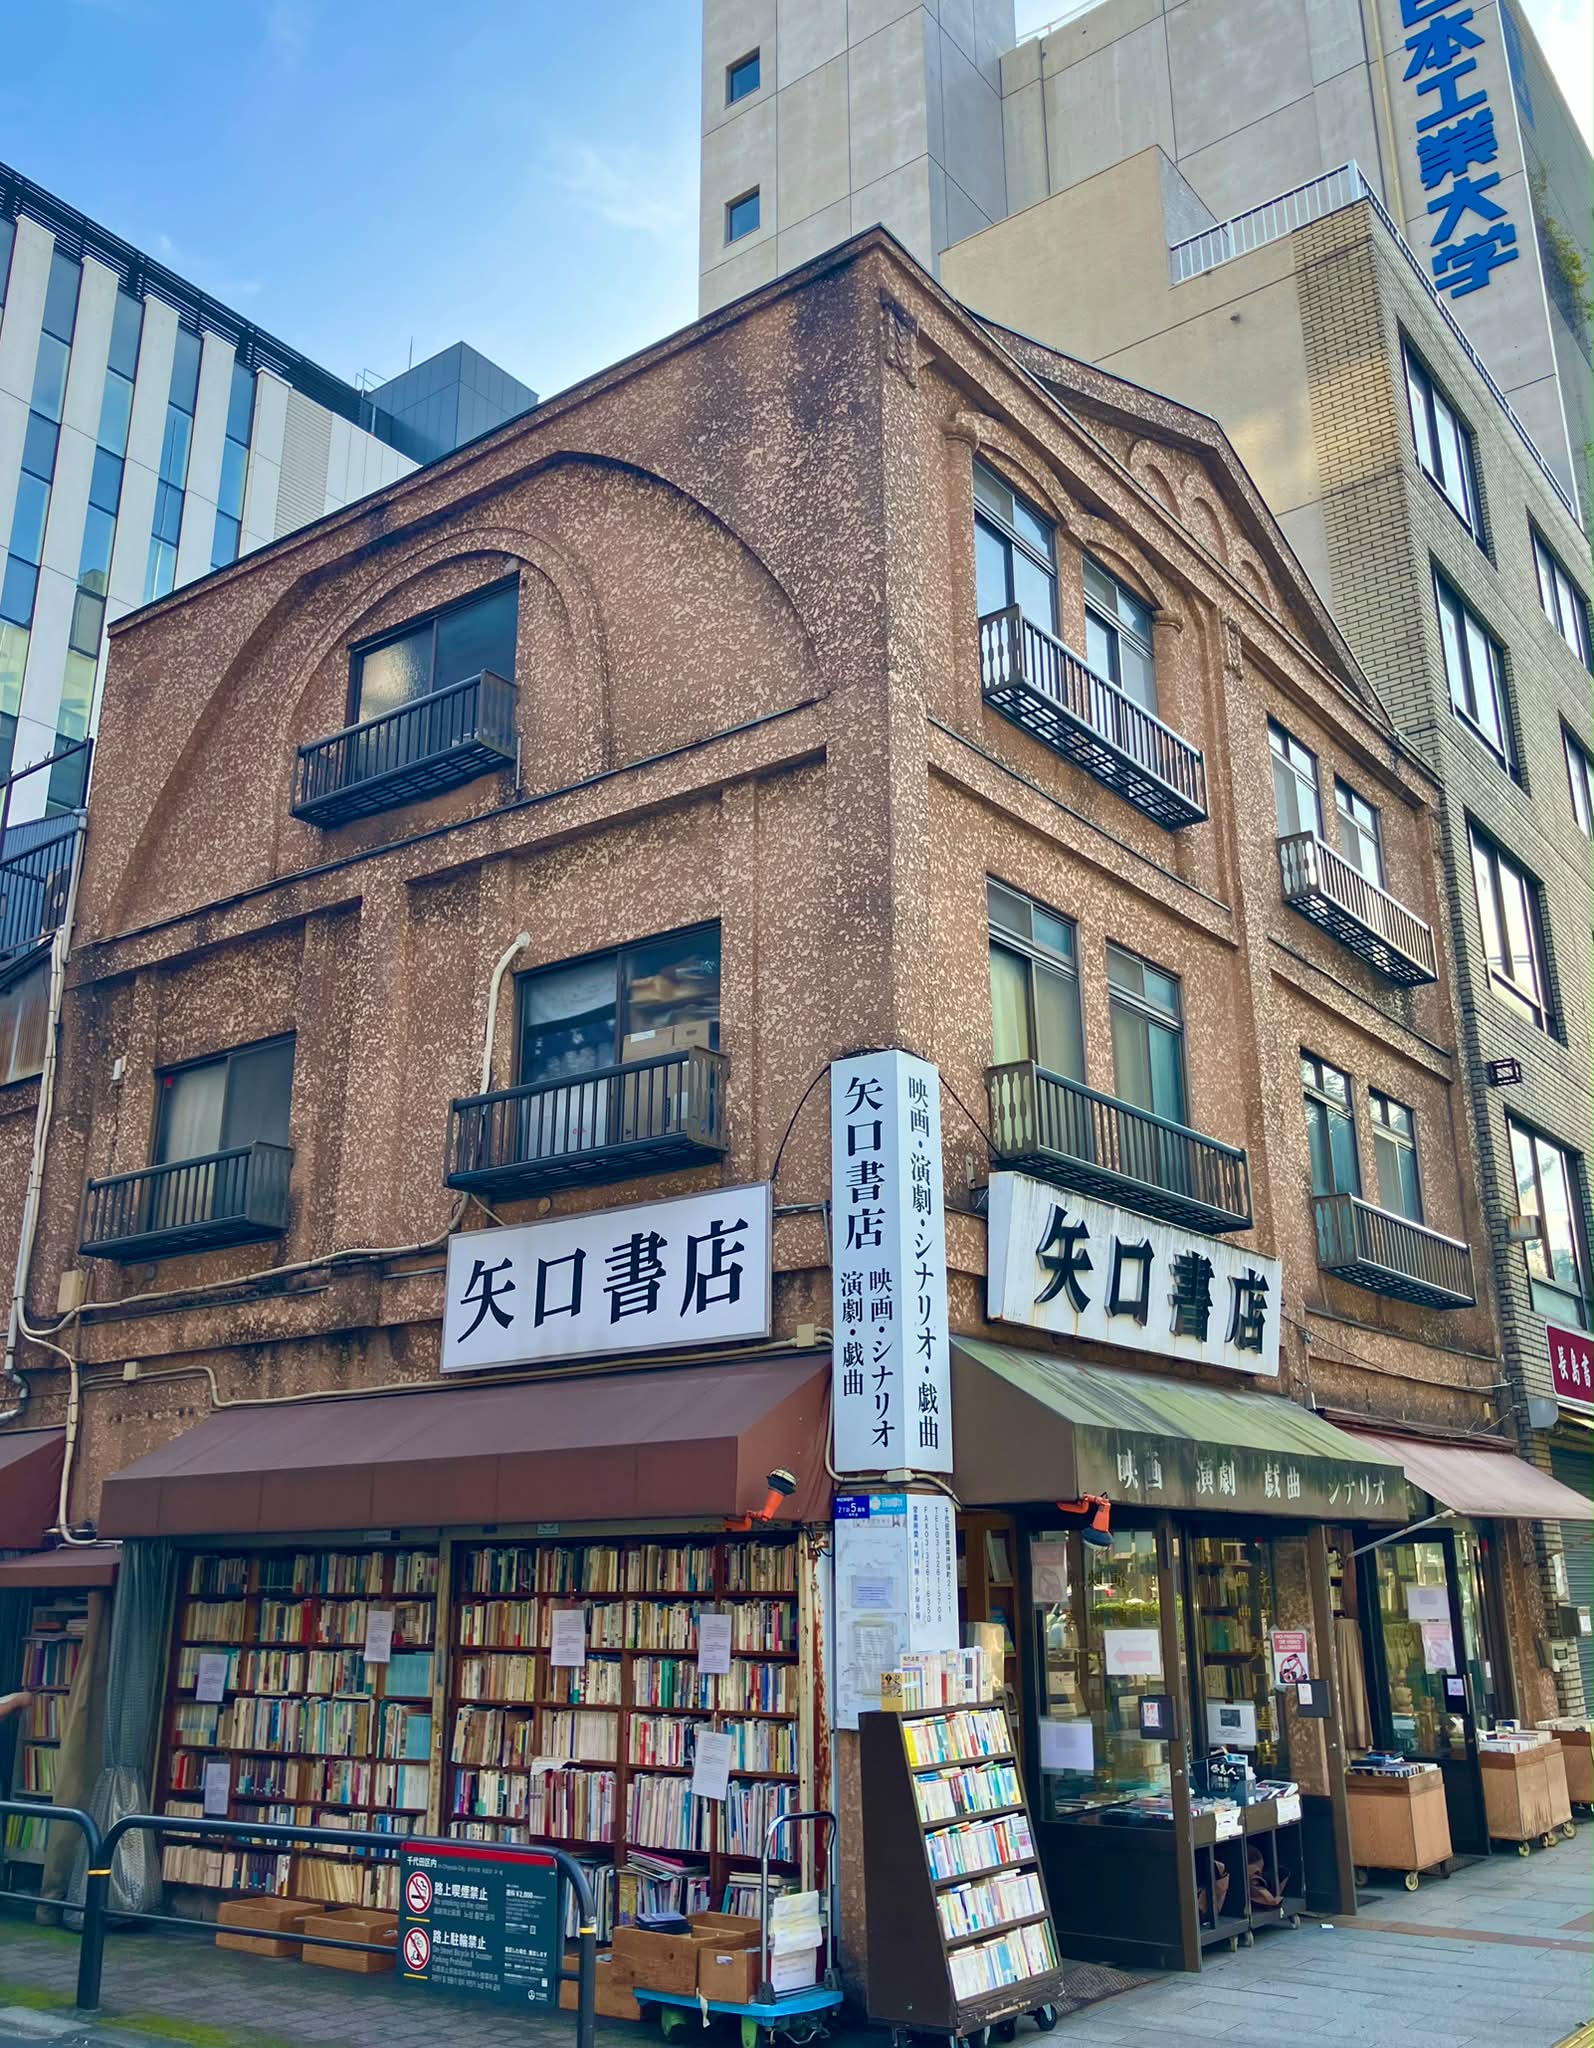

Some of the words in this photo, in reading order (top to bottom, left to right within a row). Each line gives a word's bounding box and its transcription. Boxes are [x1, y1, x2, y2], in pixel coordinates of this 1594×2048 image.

[844, 1076, 886, 1250] 矢口書店
[457, 1218, 749, 1343] 矢口書店
[908, 1076, 939, 1449] 映画・演劇・シナリオ・戯曲
[1034, 1203, 1270, 1354] 矢口書店
[840, 1271, 864, 1397] 演劇・戯曲
[869, 1267, 895, 1448] 映画・シナリオ
[1117, 1448, 1163, 1490] 映画
[1196, 1457, 1236, 1497] 演劇
[1264, 1462, 1300, 1500] 戯曲
[1328, 1474, 1385, 1505] シナリオ
[432, 1930, 486, 1950] 路上駐輪禁止
[434, 1881, 488, 1901] 路上喫煙禁止
